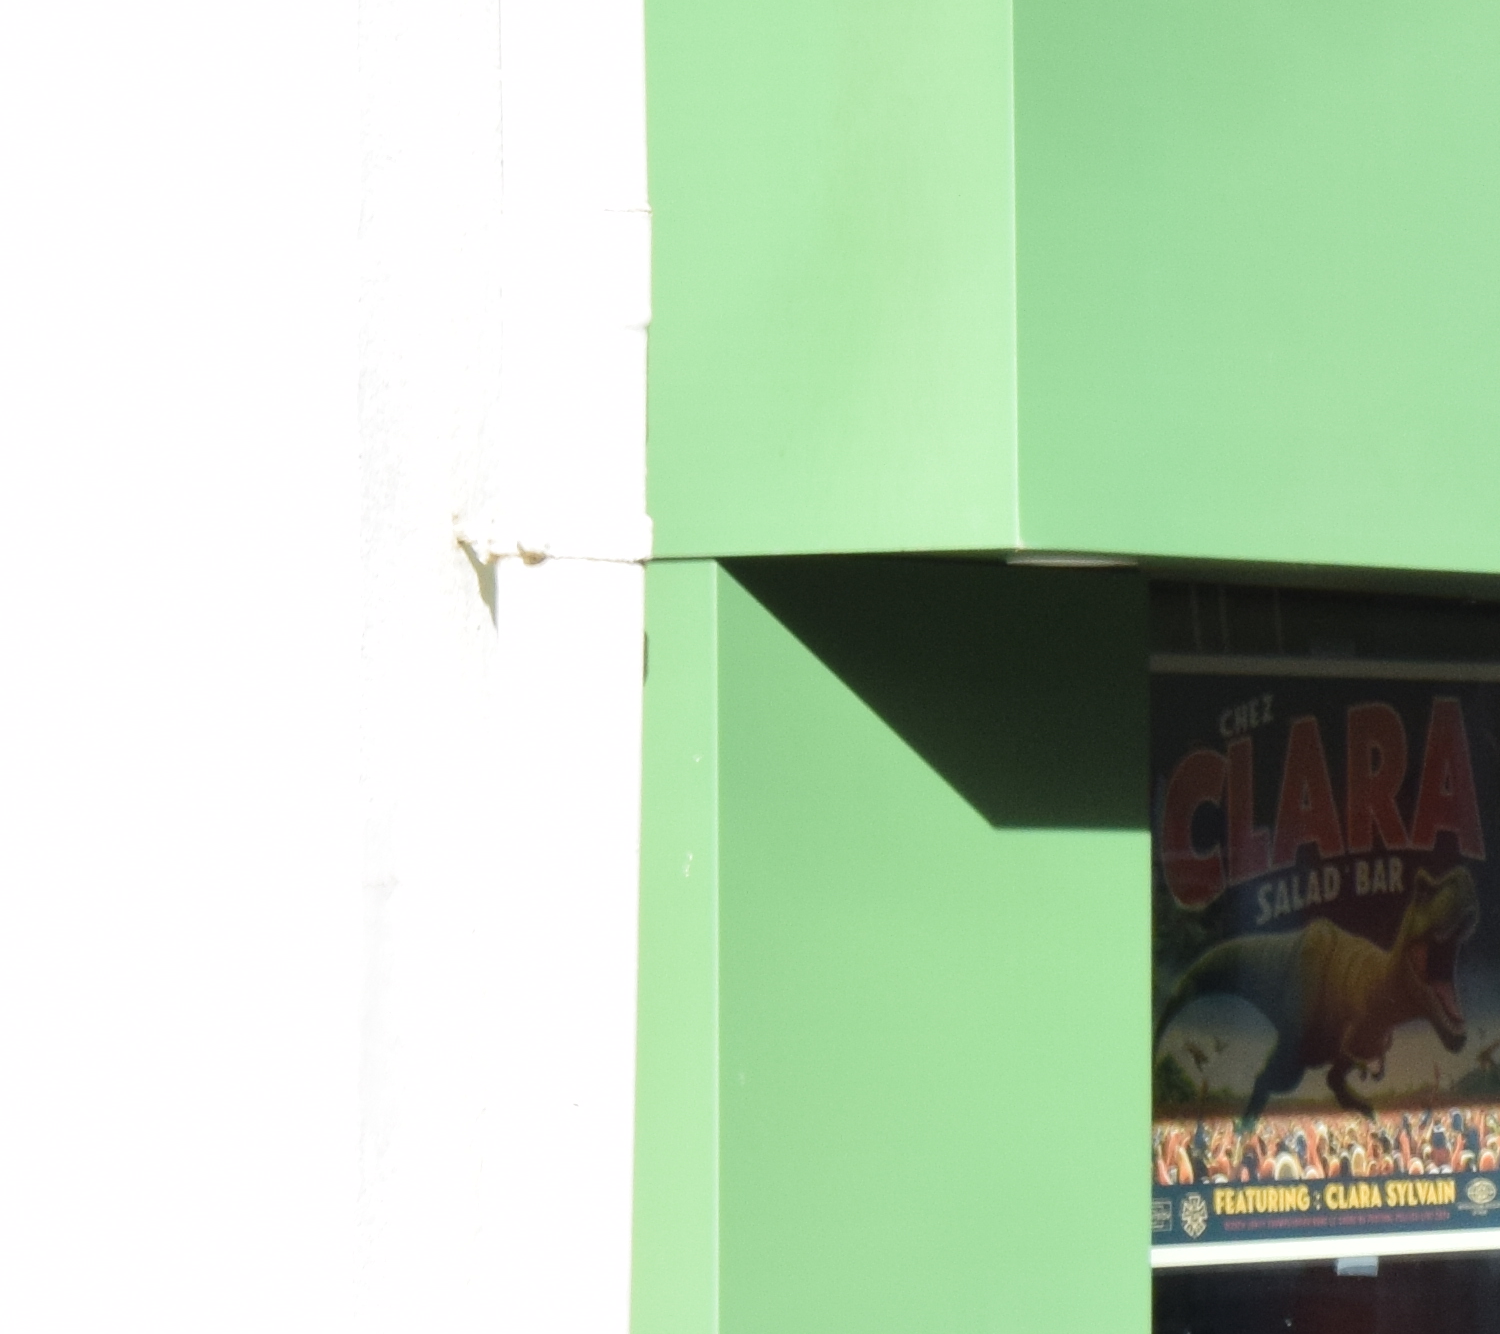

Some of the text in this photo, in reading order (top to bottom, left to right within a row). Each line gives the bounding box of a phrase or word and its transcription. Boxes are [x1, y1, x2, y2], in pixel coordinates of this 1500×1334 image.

[1219, 694, 1275, 738] CHEZ
[1161, 696, 1486, 911] CLARA
[1213, 1184, 1311, 1216] FEATURING
[1324, 1183, 1382, 1210] CLARA
[1385, 1178, 1456, 1208] SYLVAIN
